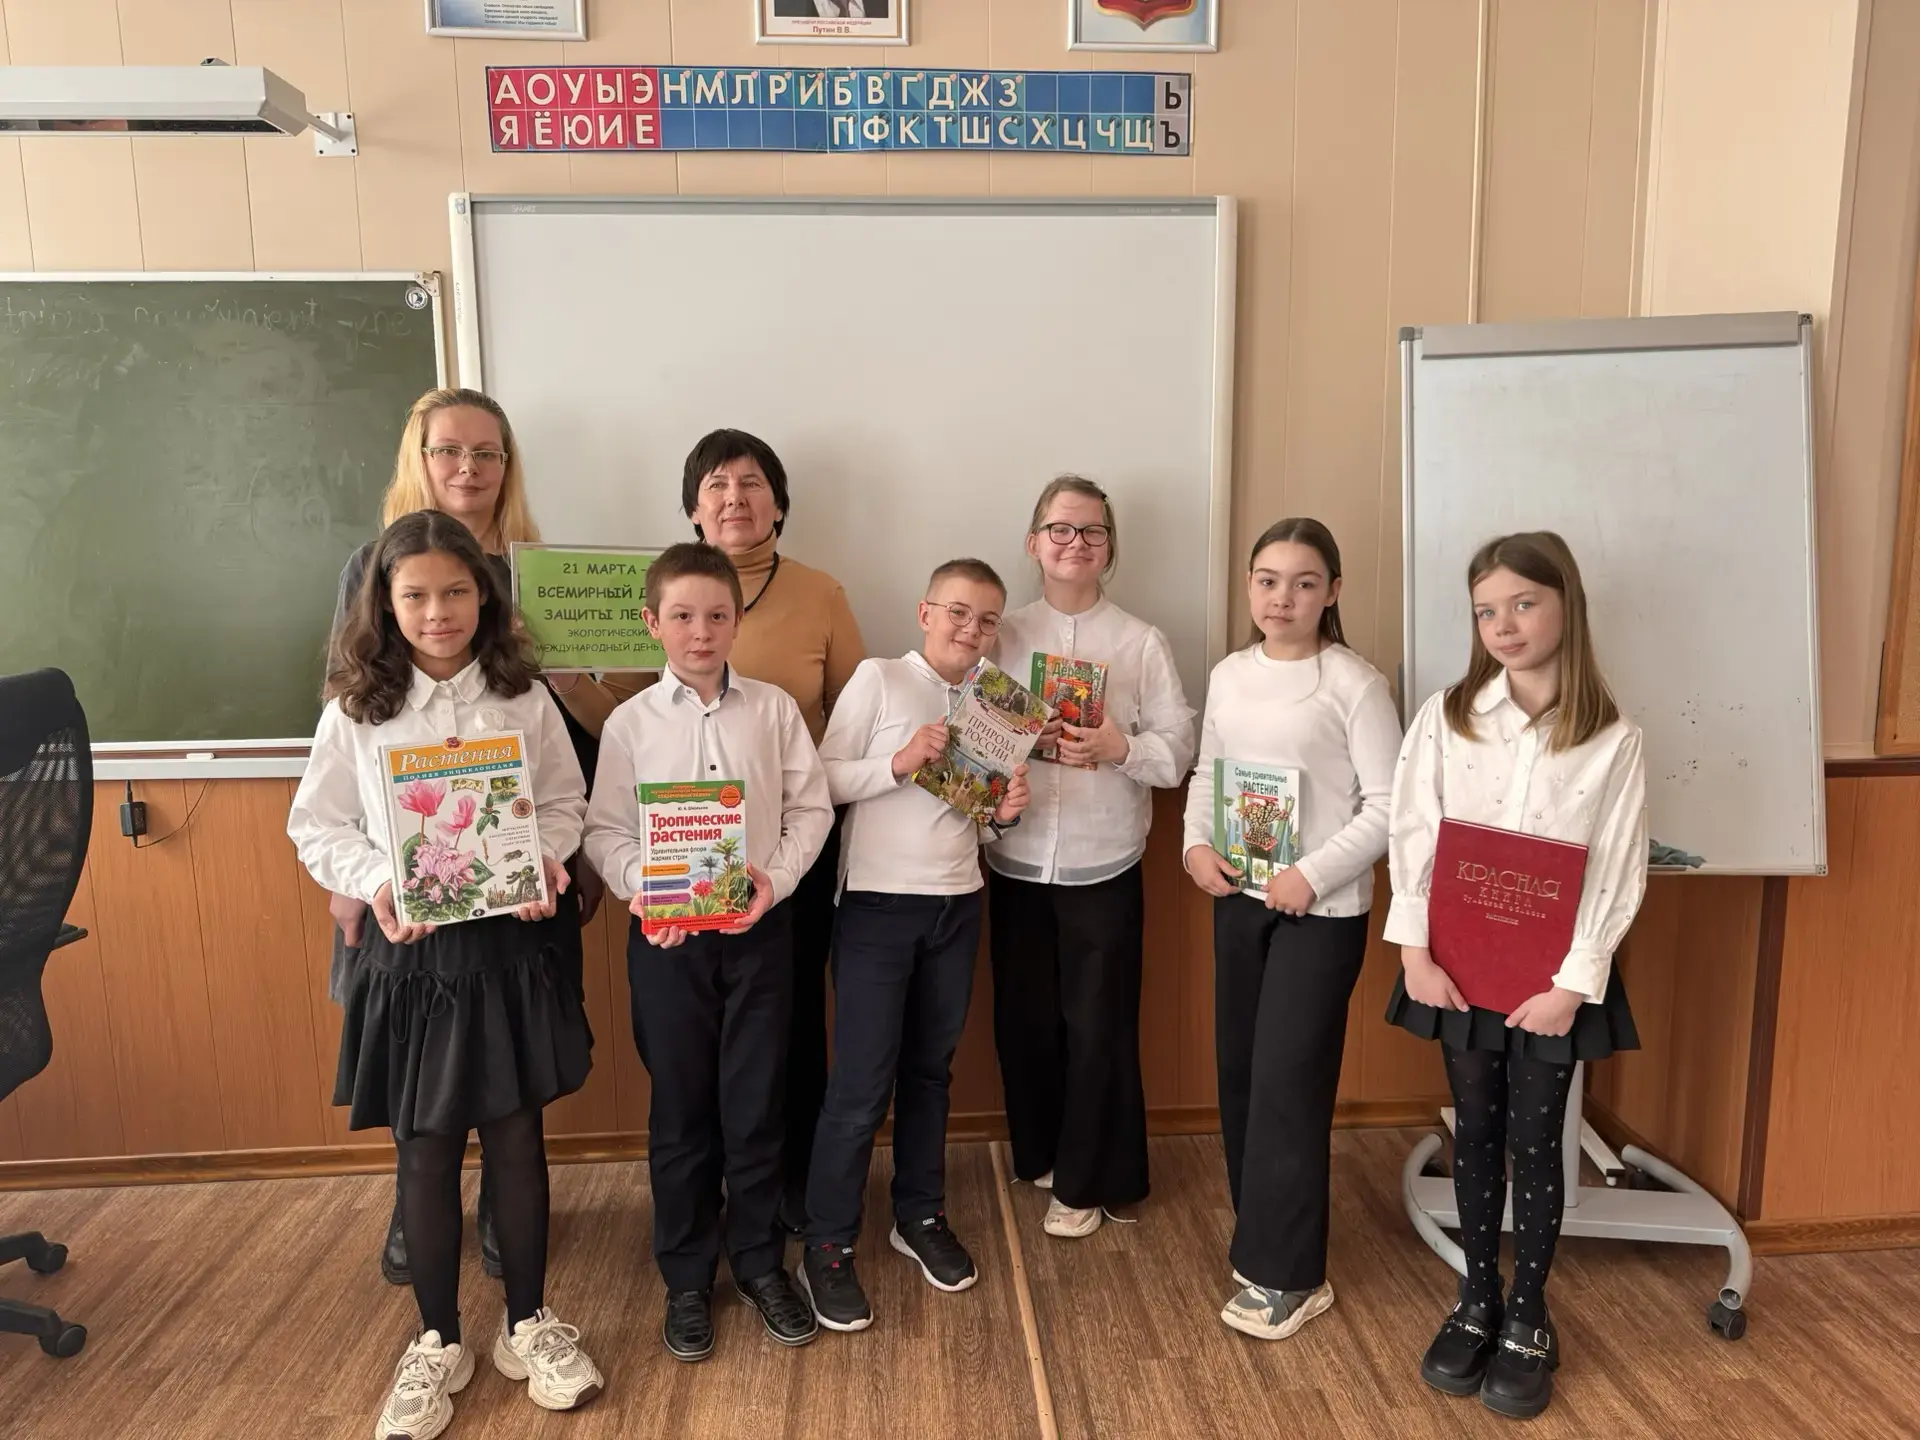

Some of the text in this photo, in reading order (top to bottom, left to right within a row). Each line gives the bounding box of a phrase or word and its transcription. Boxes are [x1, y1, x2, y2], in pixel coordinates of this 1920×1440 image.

[812, 26, 835, 34] Путин
[562, 563, 578, 574] 21
[586, 564, 636, 574] МАРТА
[538, 584, 632, 598] ВСЕМИРНЫЙ
[544, 609, 613, 622] ЗАЩИТЫ
[536, 642, 630, 652] МЕЖДУНАРОДНЫЙ
[633, 643, 658, 652] ДЕНЬ
[1052, 662, 1100, 682] Деревья
[968, 716, 1016, 754] ПРИРОДА
[964, 727, 1009, 762] РОССИИ
[400, 746, 514, 772] Растения
[1234, 767, 1288, 784] Самые удивительные
[1242, 780, 1279, 796] РАСТЕНИЯ
[650, 813, 742, 830] Тропические
[650, 828, 722, 846] растения
[650, 846, 707, 856] Удивительная флора
[1456, 860, 1562, 900] КРАСНАЯ
